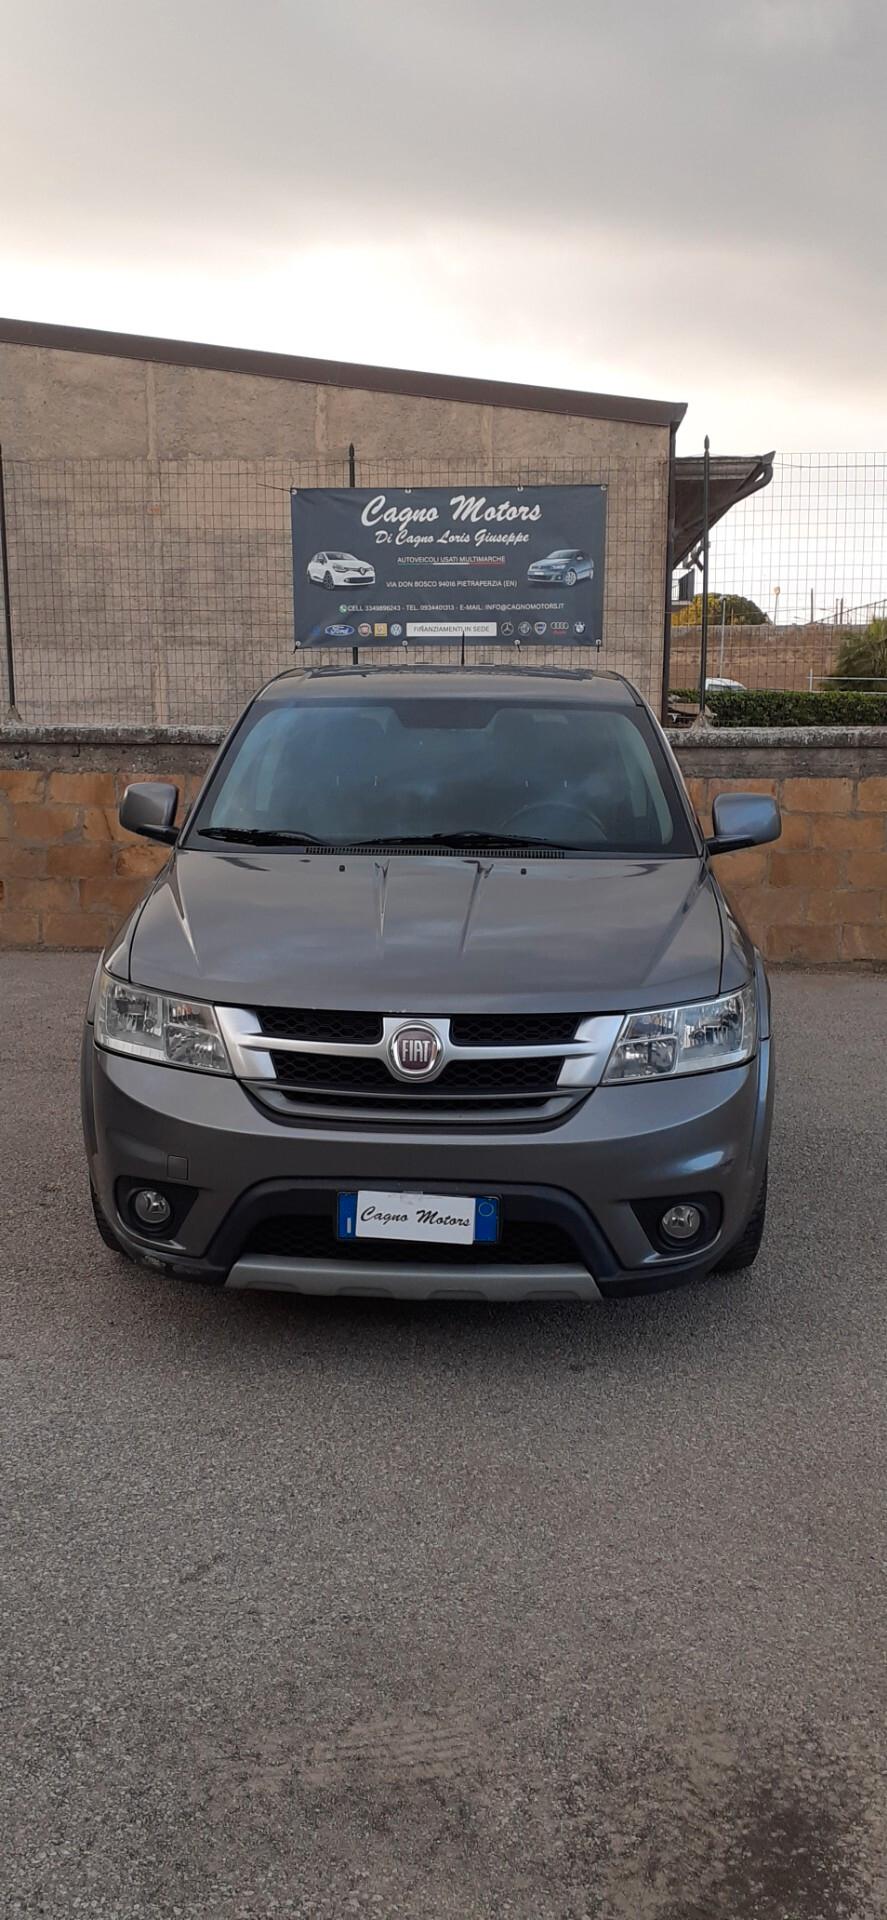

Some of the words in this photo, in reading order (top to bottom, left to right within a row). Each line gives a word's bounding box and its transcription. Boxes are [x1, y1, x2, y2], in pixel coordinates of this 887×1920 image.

[361, 495, 439, 531] Cagno
[450, 495, 542, 522] Motors
[375, 530, 393, 544] Di
[395, 528, 434, 548] Cagno
[436, 529, 470, 544] Loris
[474, 528, 530, 547] Giuseppe
[459, 555, 506, 563] MULTIMARCHE
[414, 580, 437, 588] BOSCO
[438, 580, 456, 588] 94016
[457, 580, 502, 588] PIETRAPERZIA
[503, 580, 518, 588] (EN)
[402, 1040, 431, 1062] FIAT
[360, 1205, 408, 1226] Cagno
[415, 1209, 471, 1227] Motors
